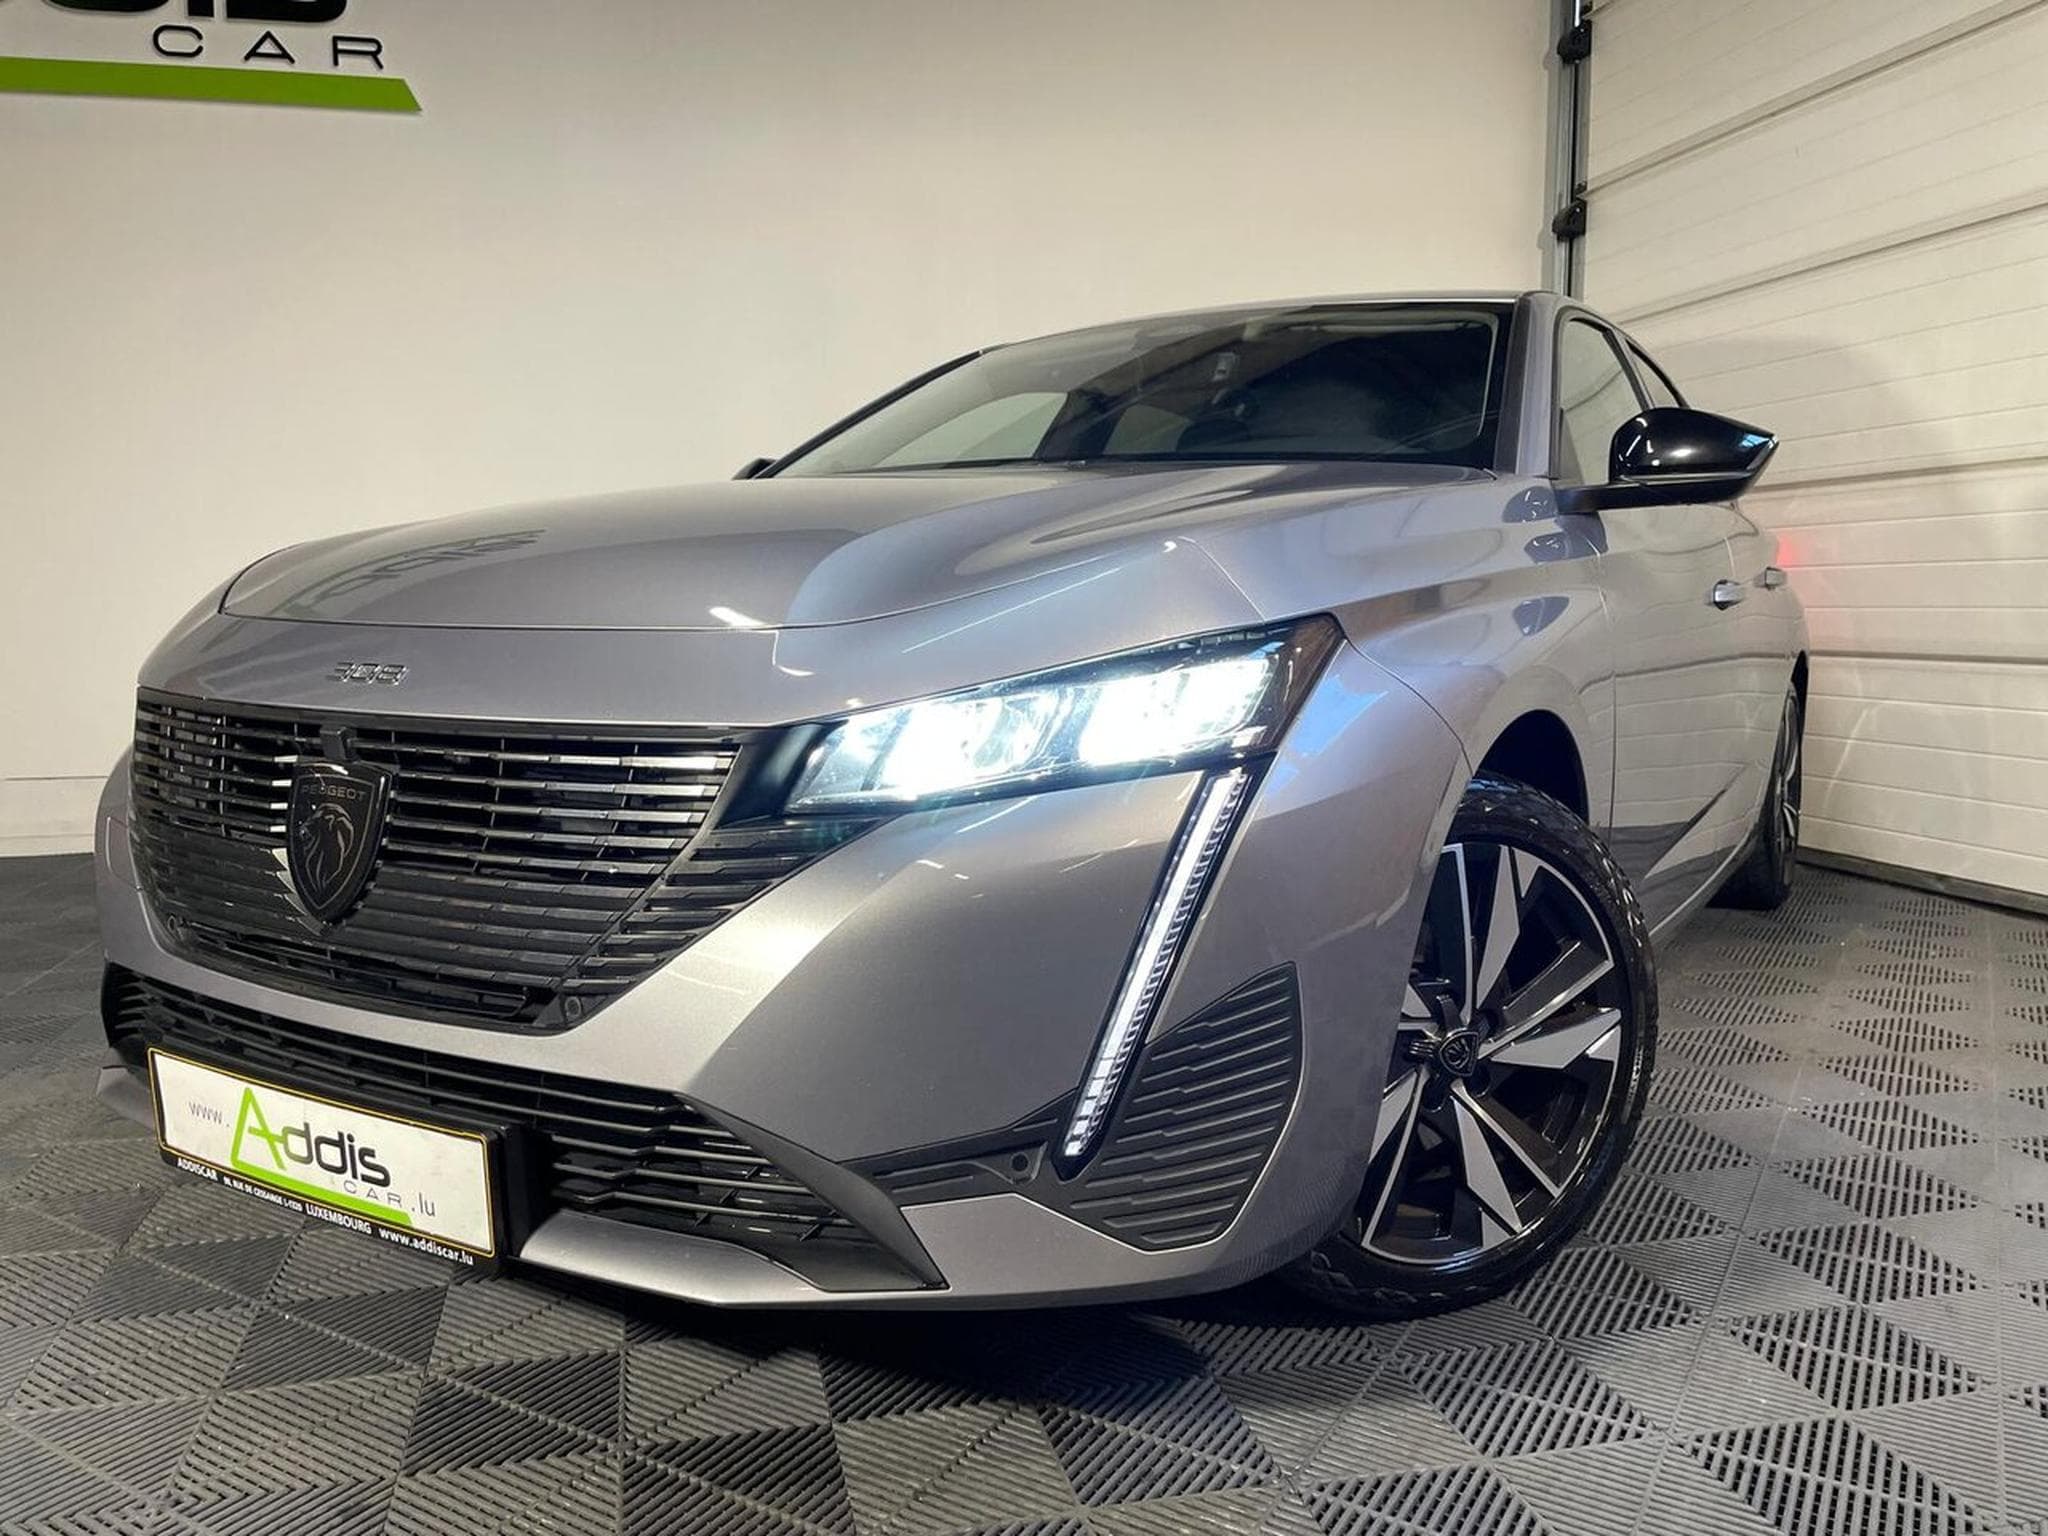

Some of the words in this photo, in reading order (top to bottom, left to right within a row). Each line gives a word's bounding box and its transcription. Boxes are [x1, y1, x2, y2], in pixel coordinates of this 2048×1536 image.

[153, 24, 384, 69] CAR
[327, 661, 410, 686] 308
[302, 783, 366, 801] PEUGEOT
[230, 1087, 391, 1188] Addis
[177, 1158, 218, 1181] ADDISCAR
[305, 1203, 373, 1234] LUXEMBOURG
[378, 1227, 475, 1266] www.addiscar.lu
[343, 1180, 402, 1208] CAR
